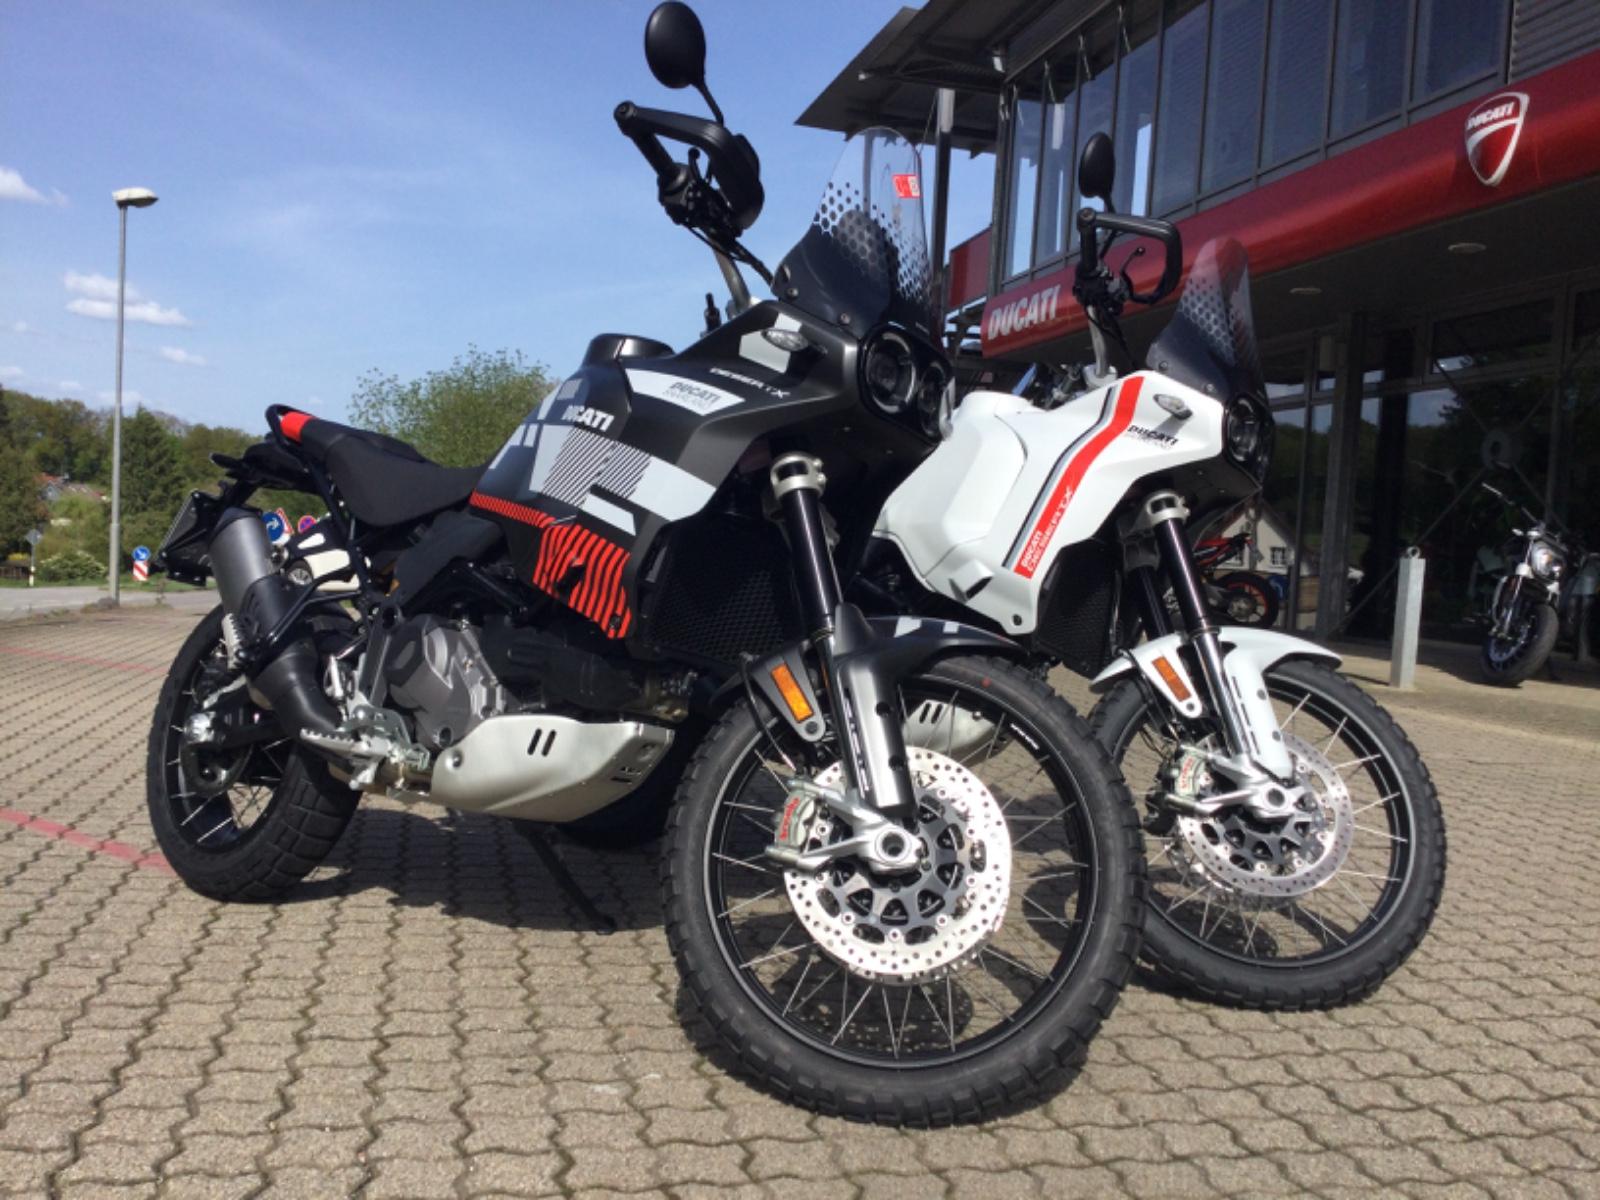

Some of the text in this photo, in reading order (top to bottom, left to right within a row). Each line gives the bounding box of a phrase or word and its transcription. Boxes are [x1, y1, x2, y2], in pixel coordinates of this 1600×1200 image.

[987, 284, 1061, 341] DUCATI
[669, 381, 721, 403] DUCATI
[1127, 425, 1179, 446] DUCATI
